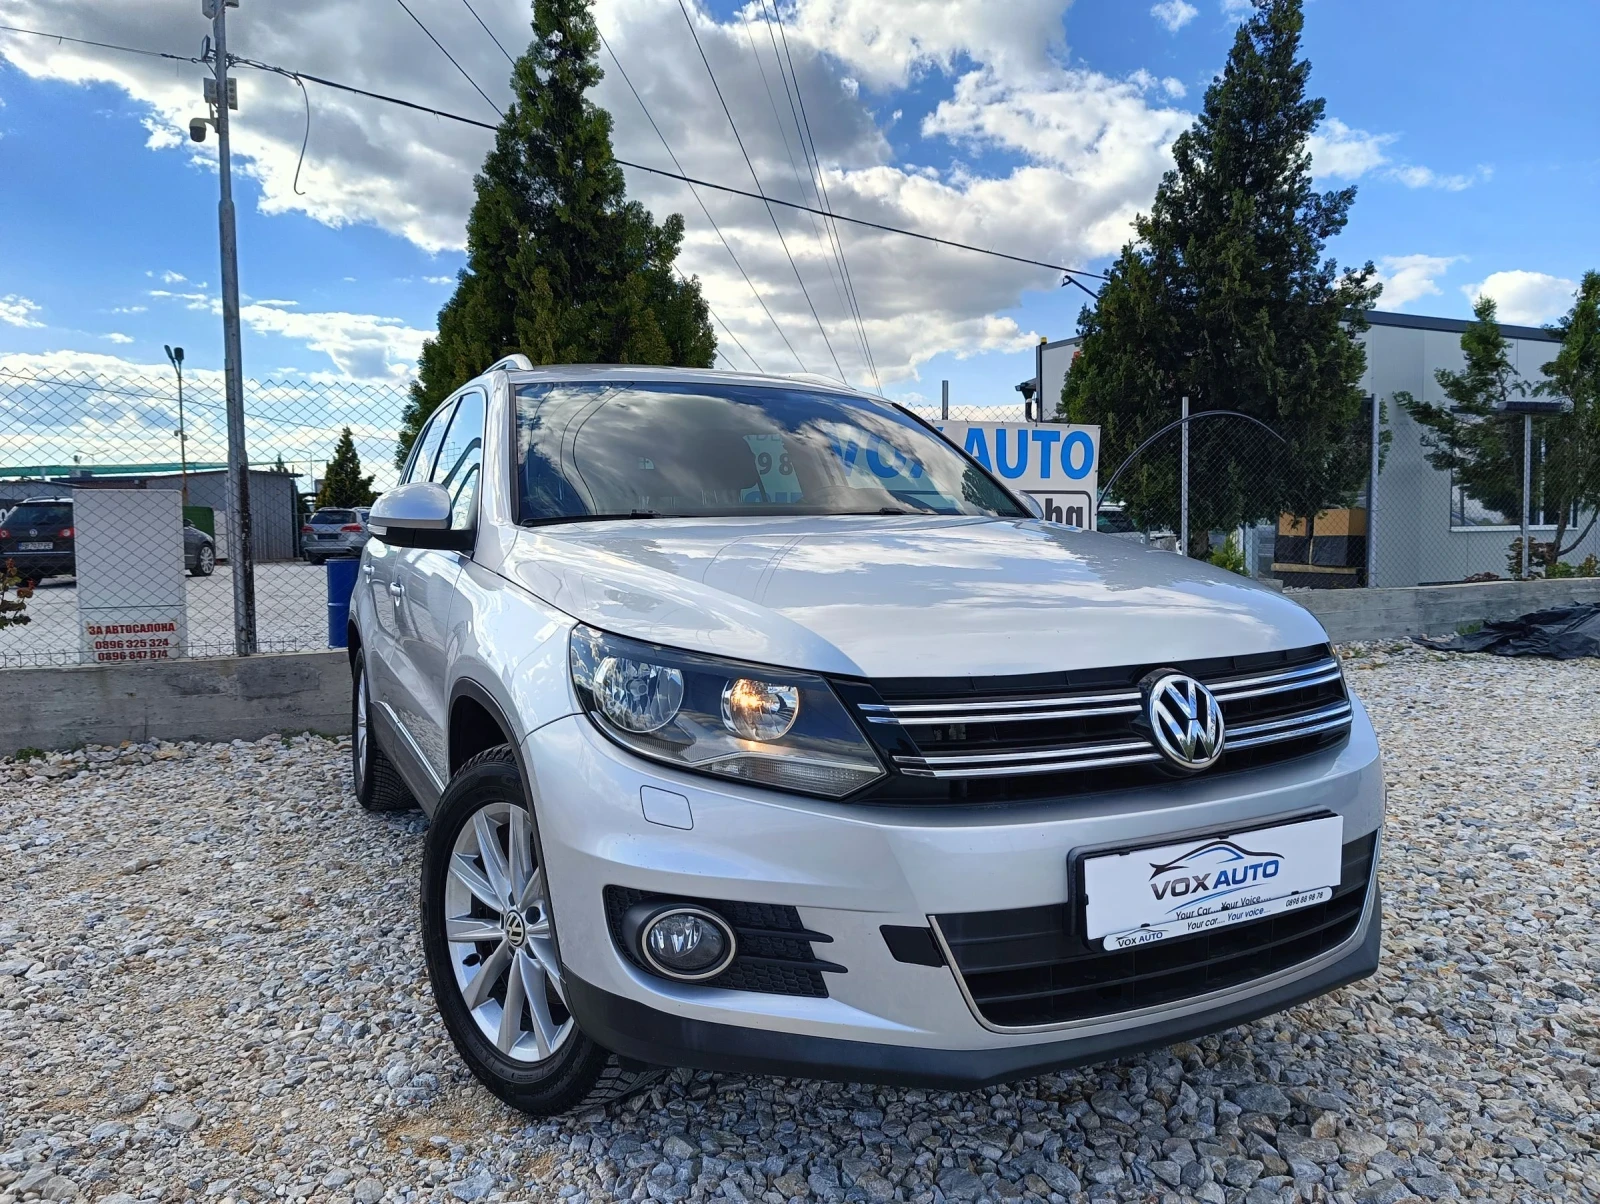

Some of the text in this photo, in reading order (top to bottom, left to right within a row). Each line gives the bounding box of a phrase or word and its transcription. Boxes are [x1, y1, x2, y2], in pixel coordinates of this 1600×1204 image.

[964, 427, 1095, 480] AUTO
[88, 623, 175, 636] ЗА АВТОСАЛОНА
[95, 638, 169, 650] 0896 325 324
[98, 650, 168, 661] 0896 847 874
[1151, 860, 1280, 900] VOX AUTO
[1187, 921, 1204, 931] Your
[1226, 911, 1243, 922] Your
[1118, 932, 1163, 948] VOX AUTO
